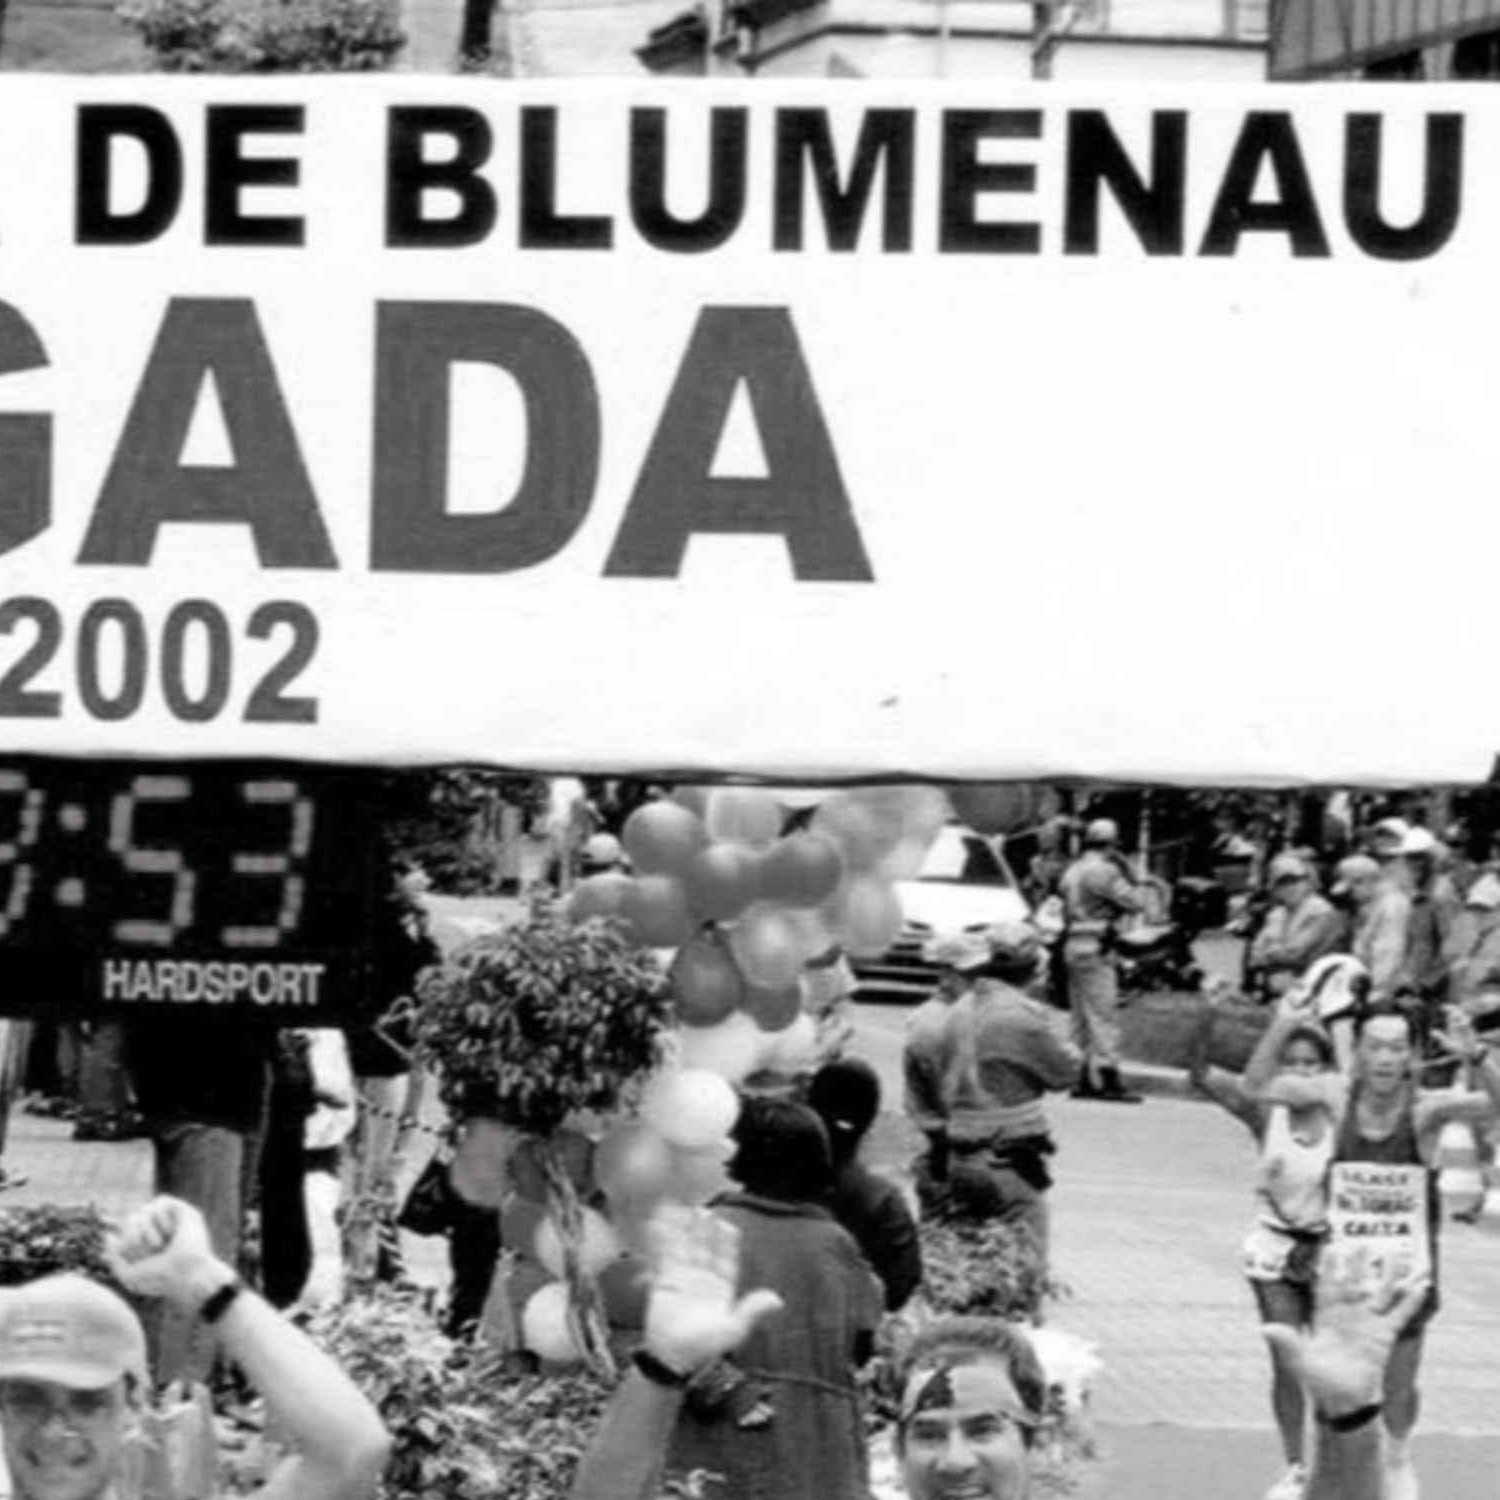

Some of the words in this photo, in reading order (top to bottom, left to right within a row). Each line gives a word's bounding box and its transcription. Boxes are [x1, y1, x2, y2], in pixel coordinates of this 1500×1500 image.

[73, 103, 307, 248] DE
[383, 104, 1465, 262] BLUMENAU
[103, 959, 327, 1006] HARDSPORT
